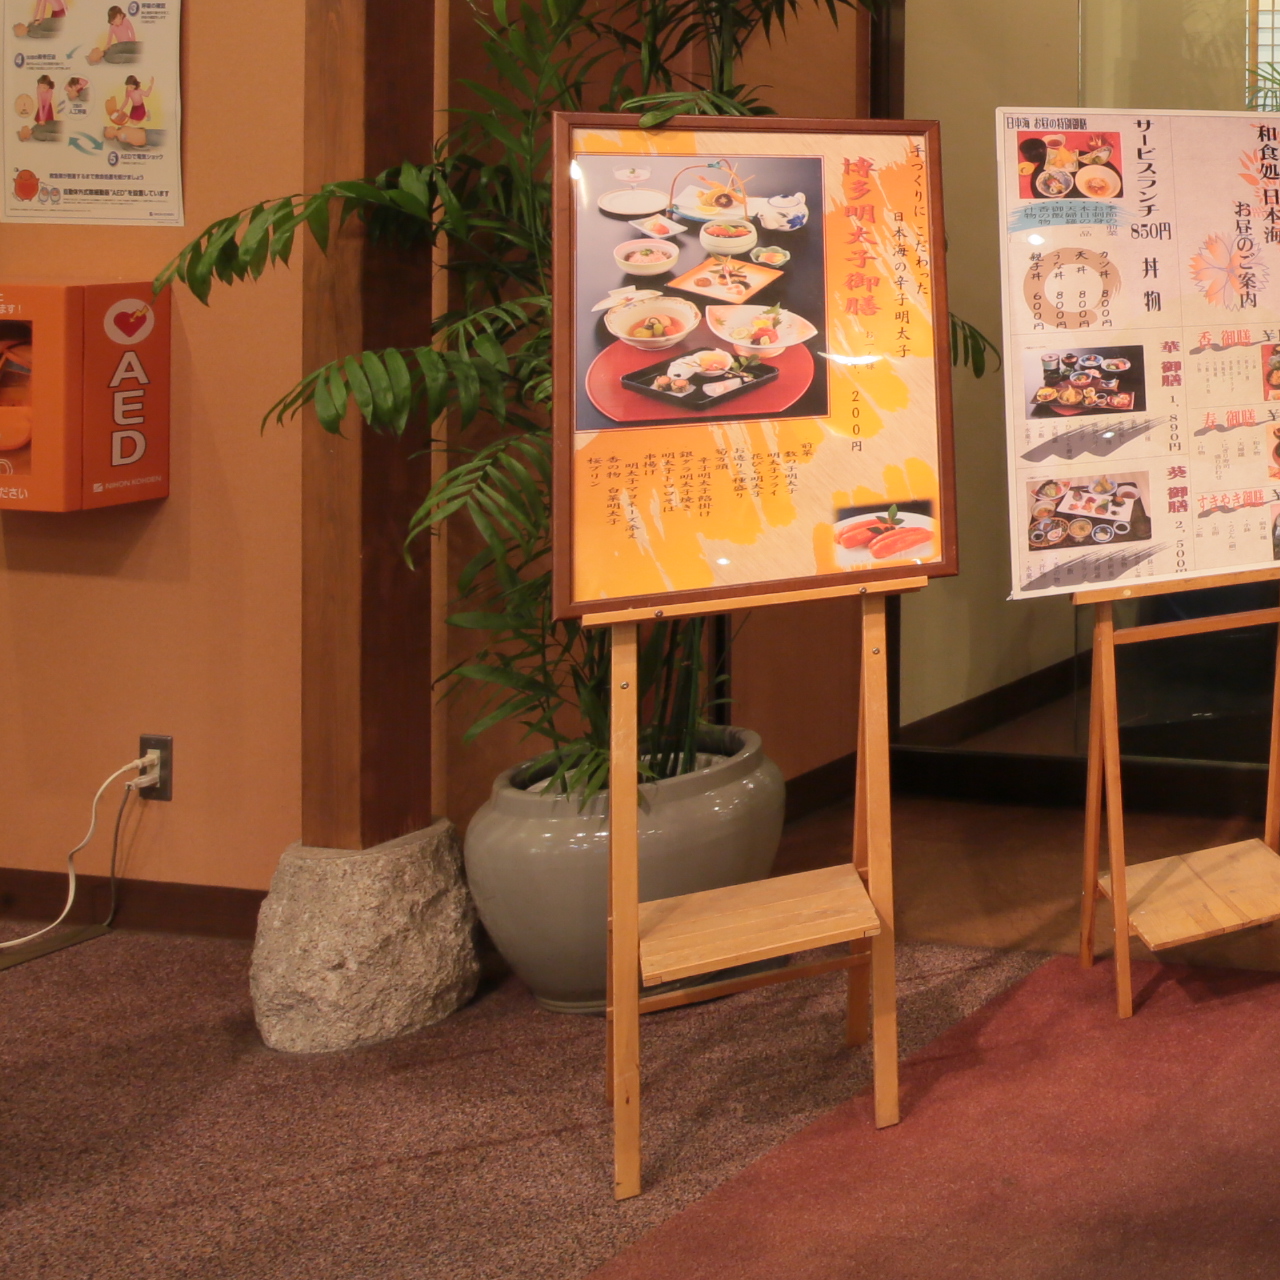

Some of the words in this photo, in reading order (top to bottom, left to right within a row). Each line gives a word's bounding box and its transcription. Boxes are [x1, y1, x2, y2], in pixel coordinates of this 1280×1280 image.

[1006, 116, 1031, 130] 日本海
[1256, 124, 1280, 181] 和食処
[911, 144, 926, 217] 手づくりに
[1132, 119, 1160, 218] サービスランチ
[842, 156, 883, 317] 博多明太子御膳
[914, 225, 930, 295] こだわった
[1130, 221, 1172, 241] 850円
[1234, 201, 1258, 309] お昼のご案内
[892, 211, 911, 359] 日本海の辛子明太子
[107, 350, 150, 468] AED
[105, 479, 130, 489] NIHON
[131, 475, 162, 486] KOHDEN
[766, 451, 781, 496] 明太子フライ
[1197, 488, 1265, 511] すきやき御膳
